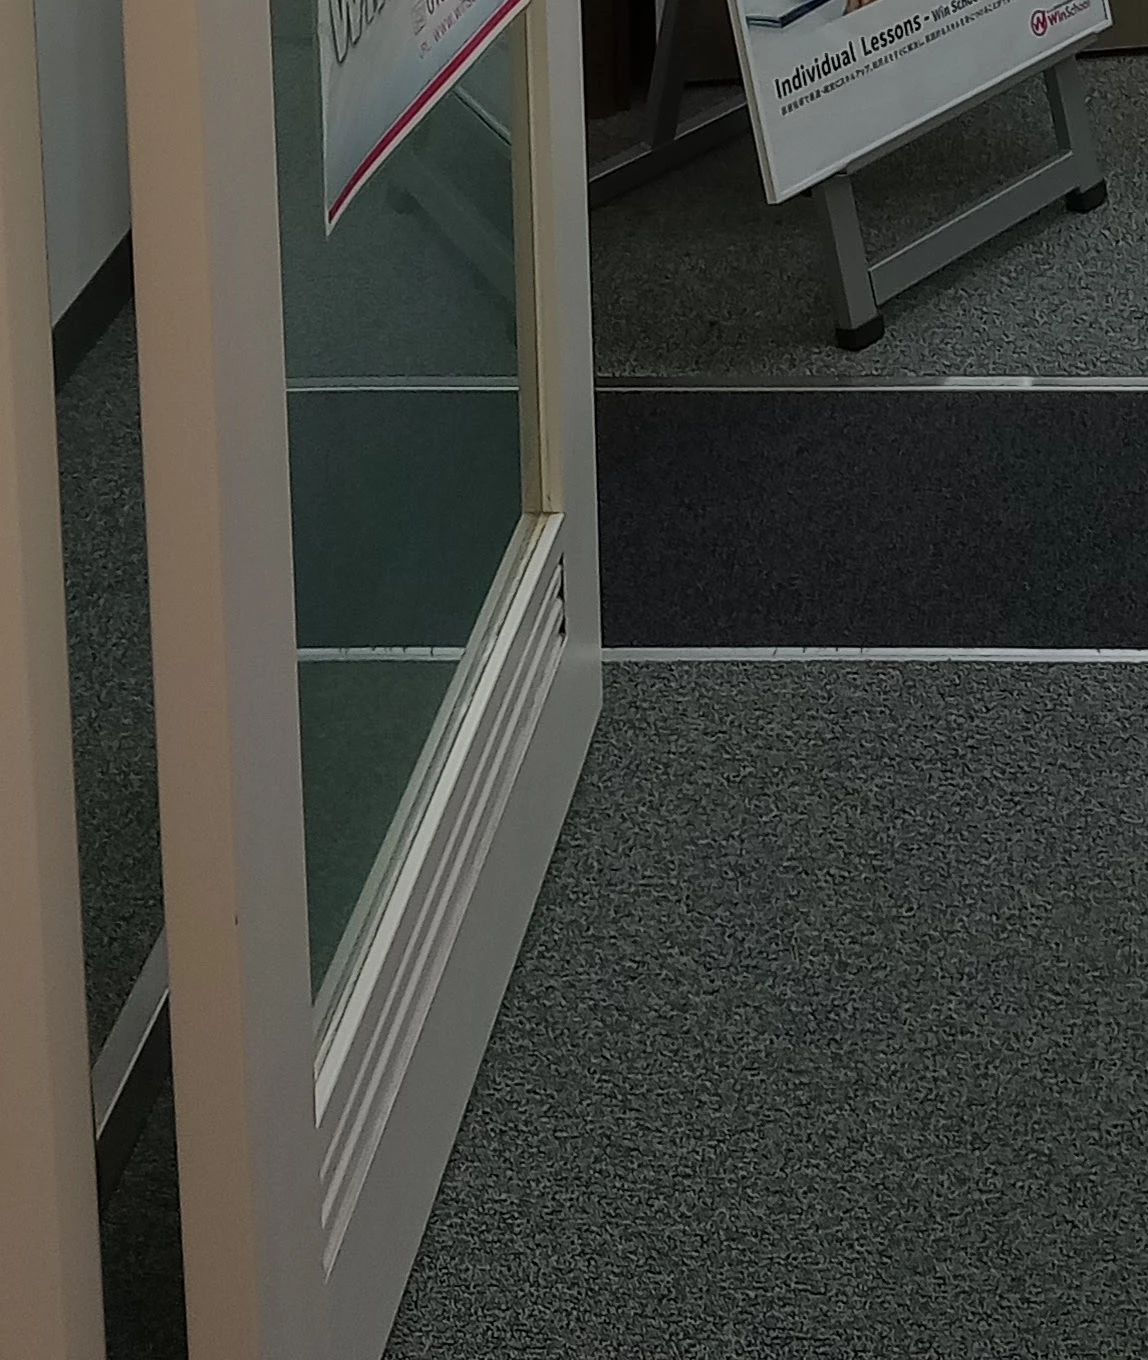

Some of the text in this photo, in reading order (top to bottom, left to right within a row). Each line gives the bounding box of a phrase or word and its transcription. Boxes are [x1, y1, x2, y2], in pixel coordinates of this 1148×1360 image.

[774, 40, 857, 100] Individual
[860, 15, 923, 58] Lessons
[931, 0, 952, 23] Win
